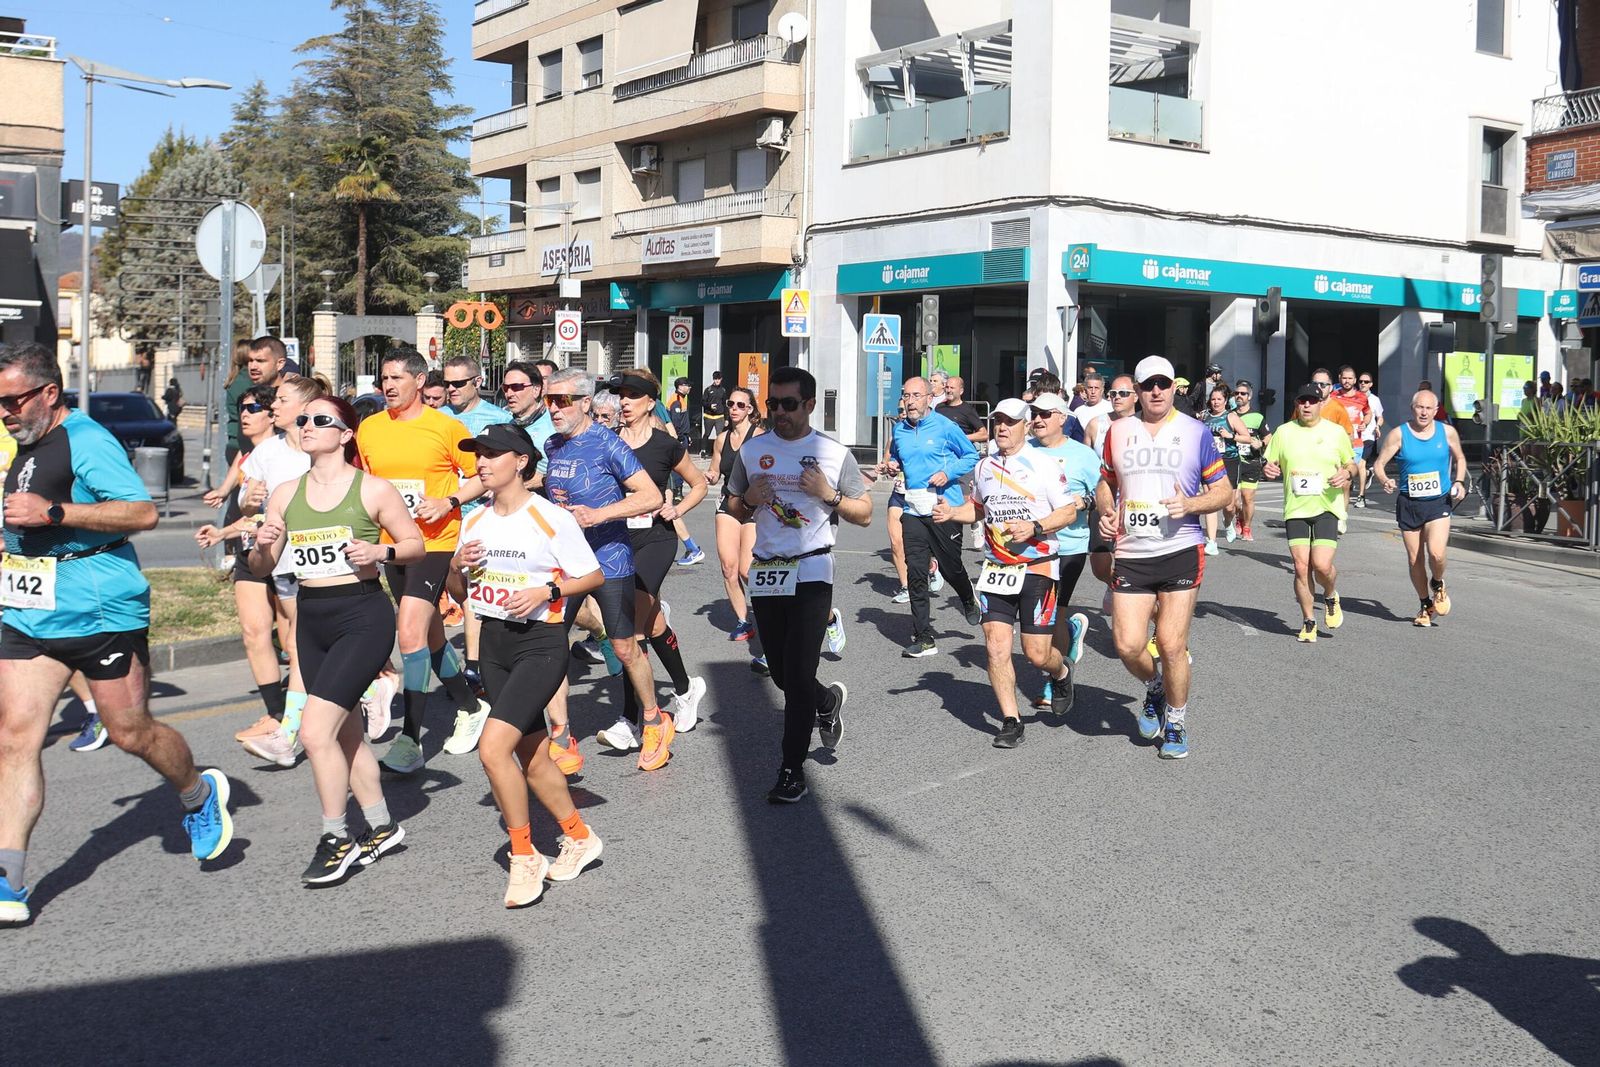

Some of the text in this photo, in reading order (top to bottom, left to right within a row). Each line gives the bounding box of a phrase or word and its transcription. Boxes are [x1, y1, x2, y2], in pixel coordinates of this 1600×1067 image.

[645, 236, 676, 257] Auditas
[542, 244, 592, 272] ASESORIA
[894, 264, 930, 284] cajamar
[1161, 263, 1212, 283] cajamar
[706, 282, 734, 299] cajamar
[1330, 278, 1374, 297] cajamar
[562, 326, 575, 334] 30
[1122, 447, 1184, 469] SOTO
[1300, 479, 1308, 489] 2
[1410, 480, 1439, 492] 3020
[1129, 512, 1160, 527] 993
[484, 550, 526, 560] ARRERA
[8, 573, 43, 596] 142
[755, 570, 790, 587] 557
[986, 572, 1018, 588] 870
